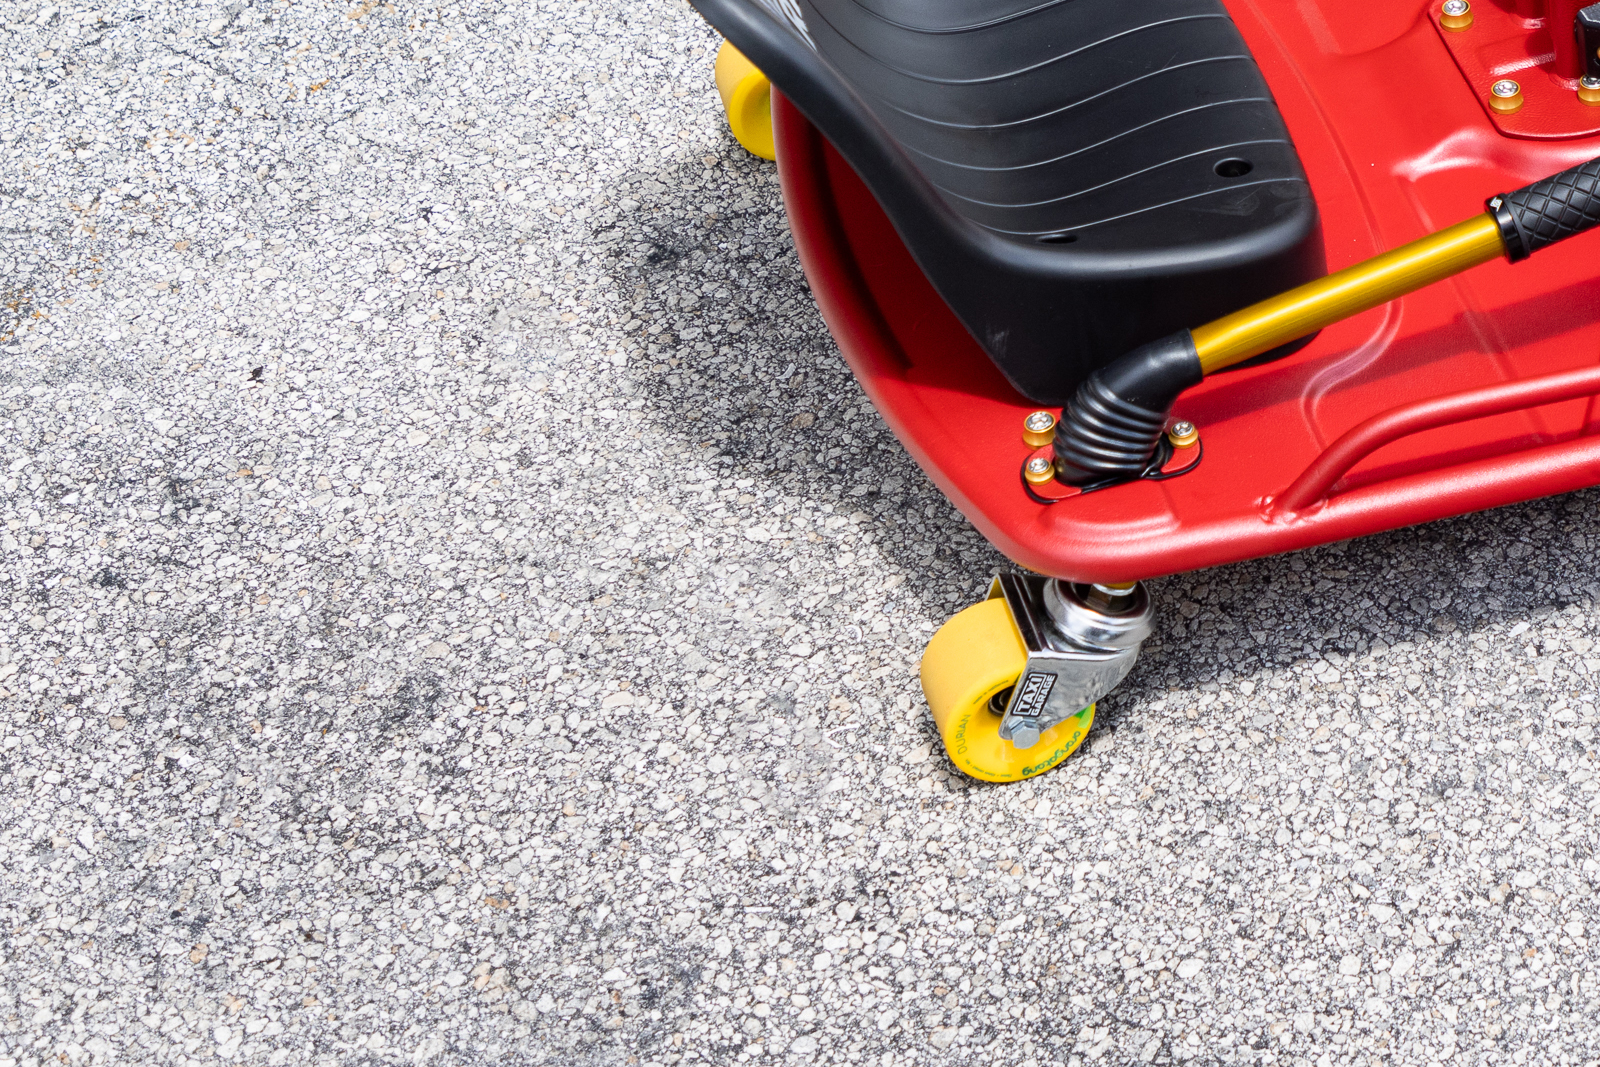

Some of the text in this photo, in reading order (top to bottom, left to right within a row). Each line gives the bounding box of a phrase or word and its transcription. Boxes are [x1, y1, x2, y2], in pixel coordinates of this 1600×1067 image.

[1016, 677, 1043, 712] TAXI
[1030, 674, 1056, 716] GARAGE
[954, 714, 971, 755] DURIAN
[1022, 730, 1081, 776] orangatang
